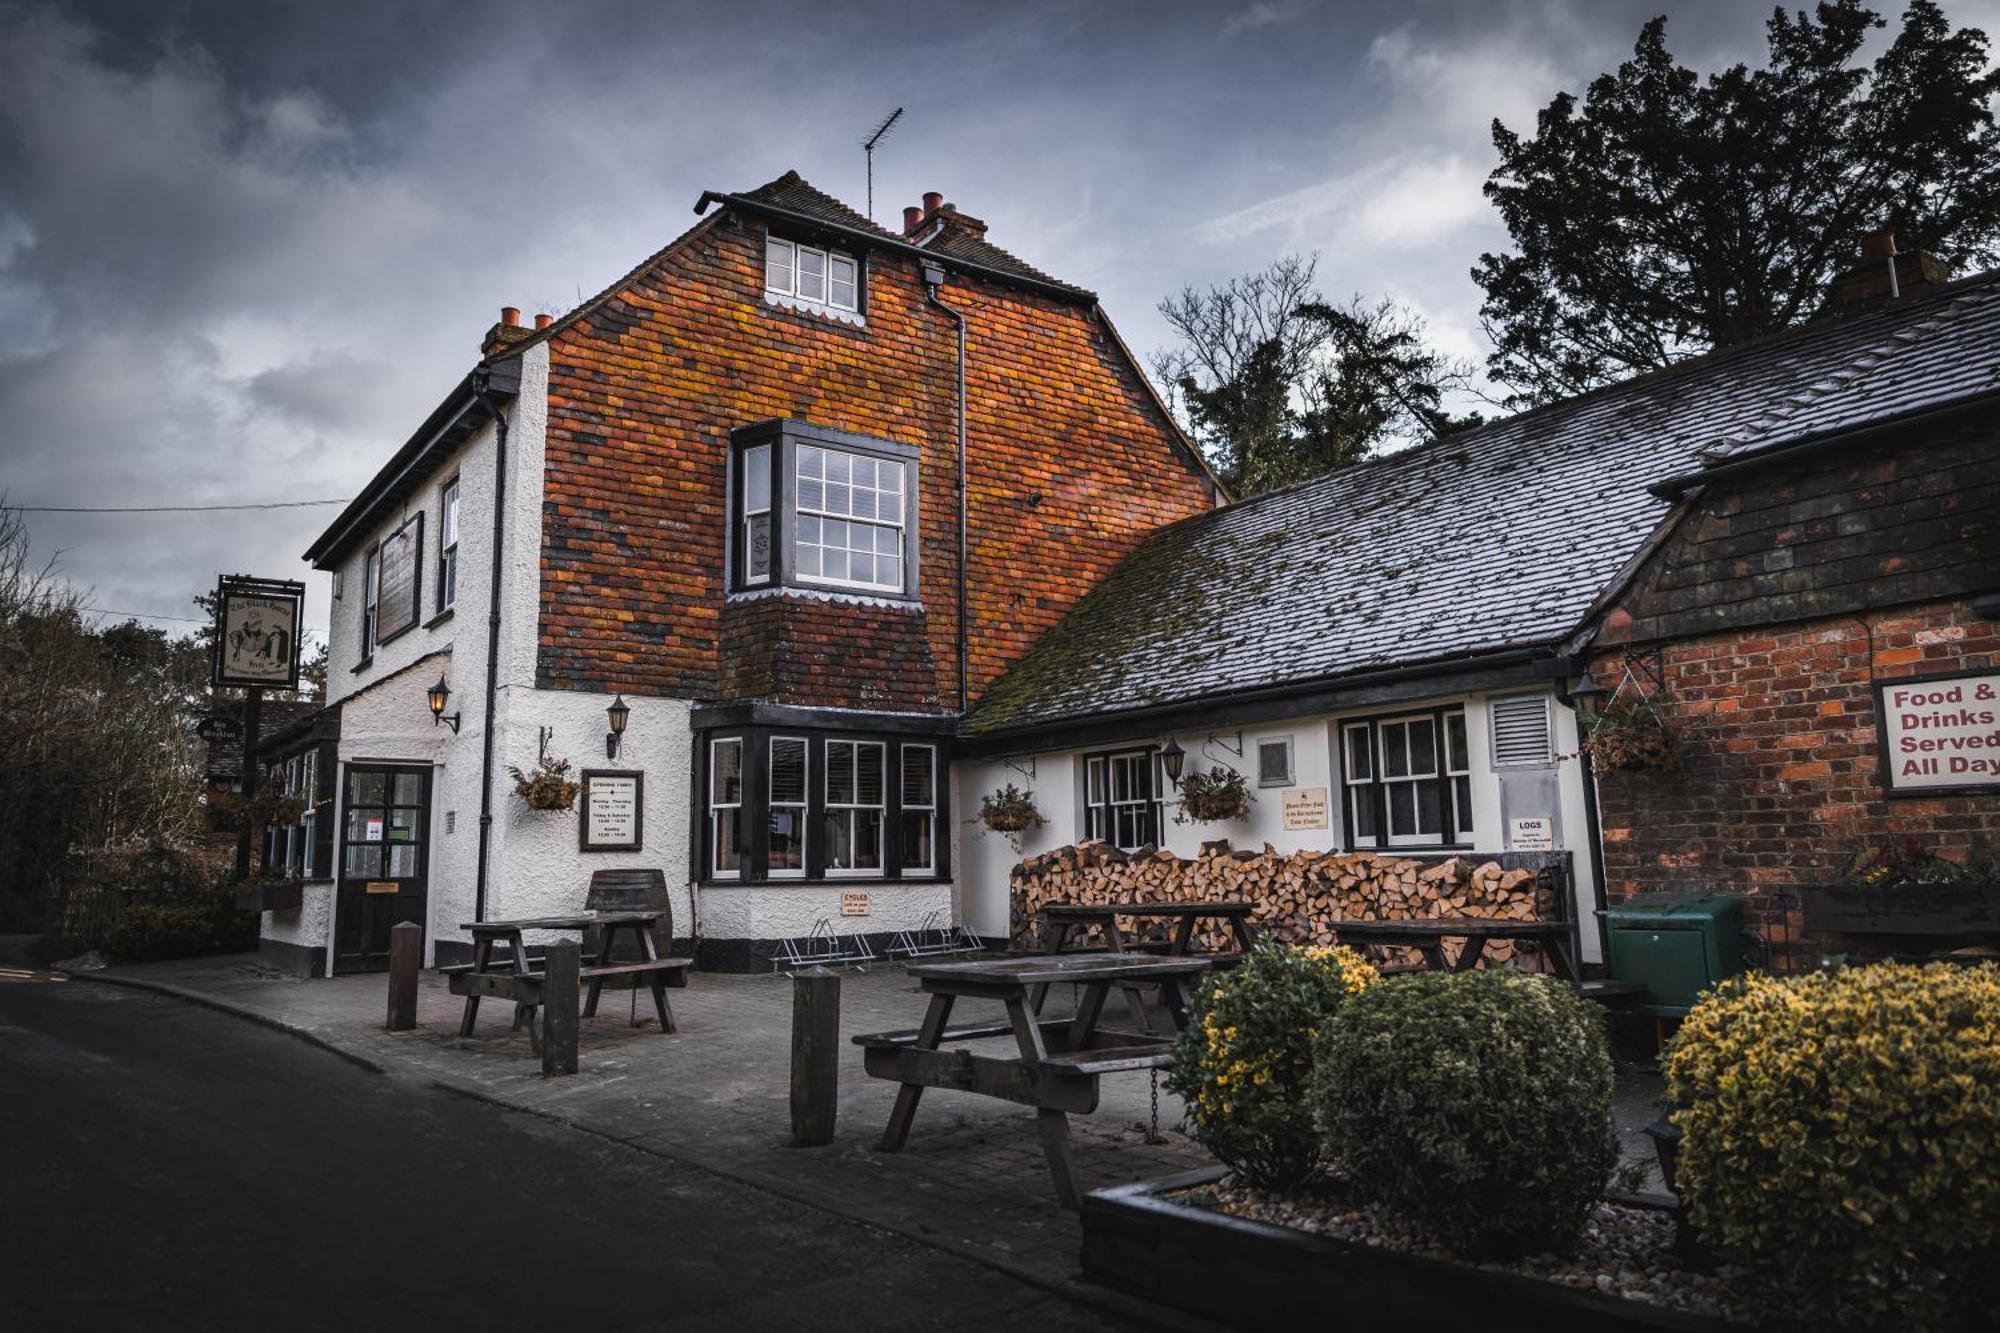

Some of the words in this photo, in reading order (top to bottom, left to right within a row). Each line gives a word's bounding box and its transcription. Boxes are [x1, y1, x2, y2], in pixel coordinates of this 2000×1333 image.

[1894, 686, 1962, 708] Food
[1975, 683, 1996, 700] &
[1901, 709, 1995, 730] Drinks
[1900, 730, 2000, 753] Served
[1902, 758, 1938, 776] All
[1949, 756, 2000, 776] Day
[1520, 821, 1542, 829] LOGS
